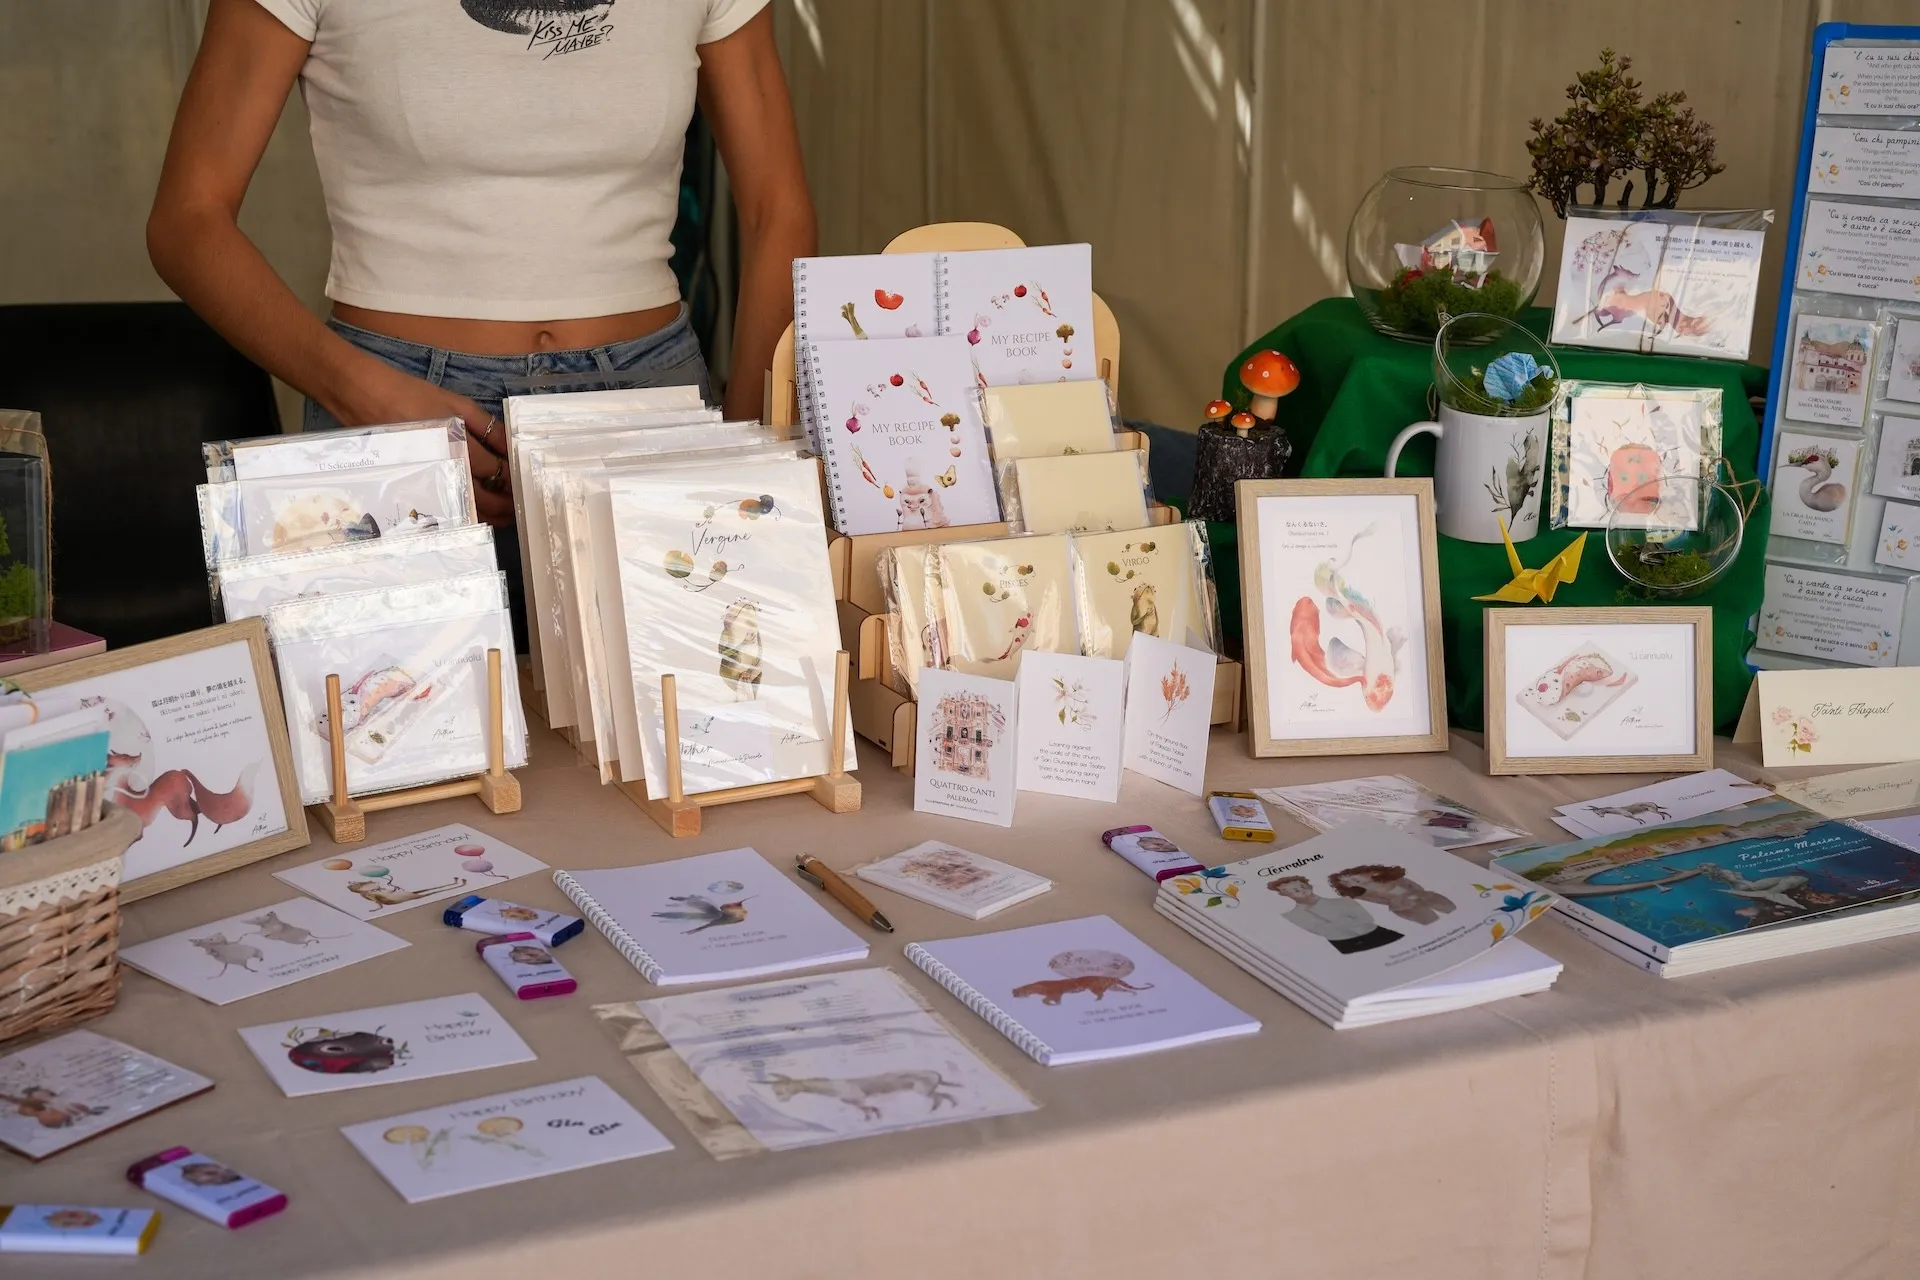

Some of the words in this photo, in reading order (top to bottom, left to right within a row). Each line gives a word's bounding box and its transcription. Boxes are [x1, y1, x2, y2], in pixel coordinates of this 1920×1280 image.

[564, 14, 599, 40] ME
[542, 24, 615, 61] MAYBE?
[991, 333, 1010, 346] MY
[1011, 331, 1052, 345] RECIPE
[1005, 346, 1038, 359] BOOK
[871, 422, 892, 435] MY
[893, 420, 936, 434] RECIPE
[888, 434, 924, 447] BOOK
[692, 527, 752, 556] Vergine
[1121, 555, 1151, 568] VIRGO
[1811, 701, 1845, 719] Tanti
[1847, 701, 1895, 719] Auguri!
[929, 777, 969, 793] QUATTRO
[969, 786, 996, 799] CANTI
[946, 793, 979, 805] PALERMO
[368, 848, 414, 864] Happy
[1737, 847, 1791, 863] Palermo
[1793, 836, 1842, 850] Marina
[424, 1018, 476, 1031] Happy
